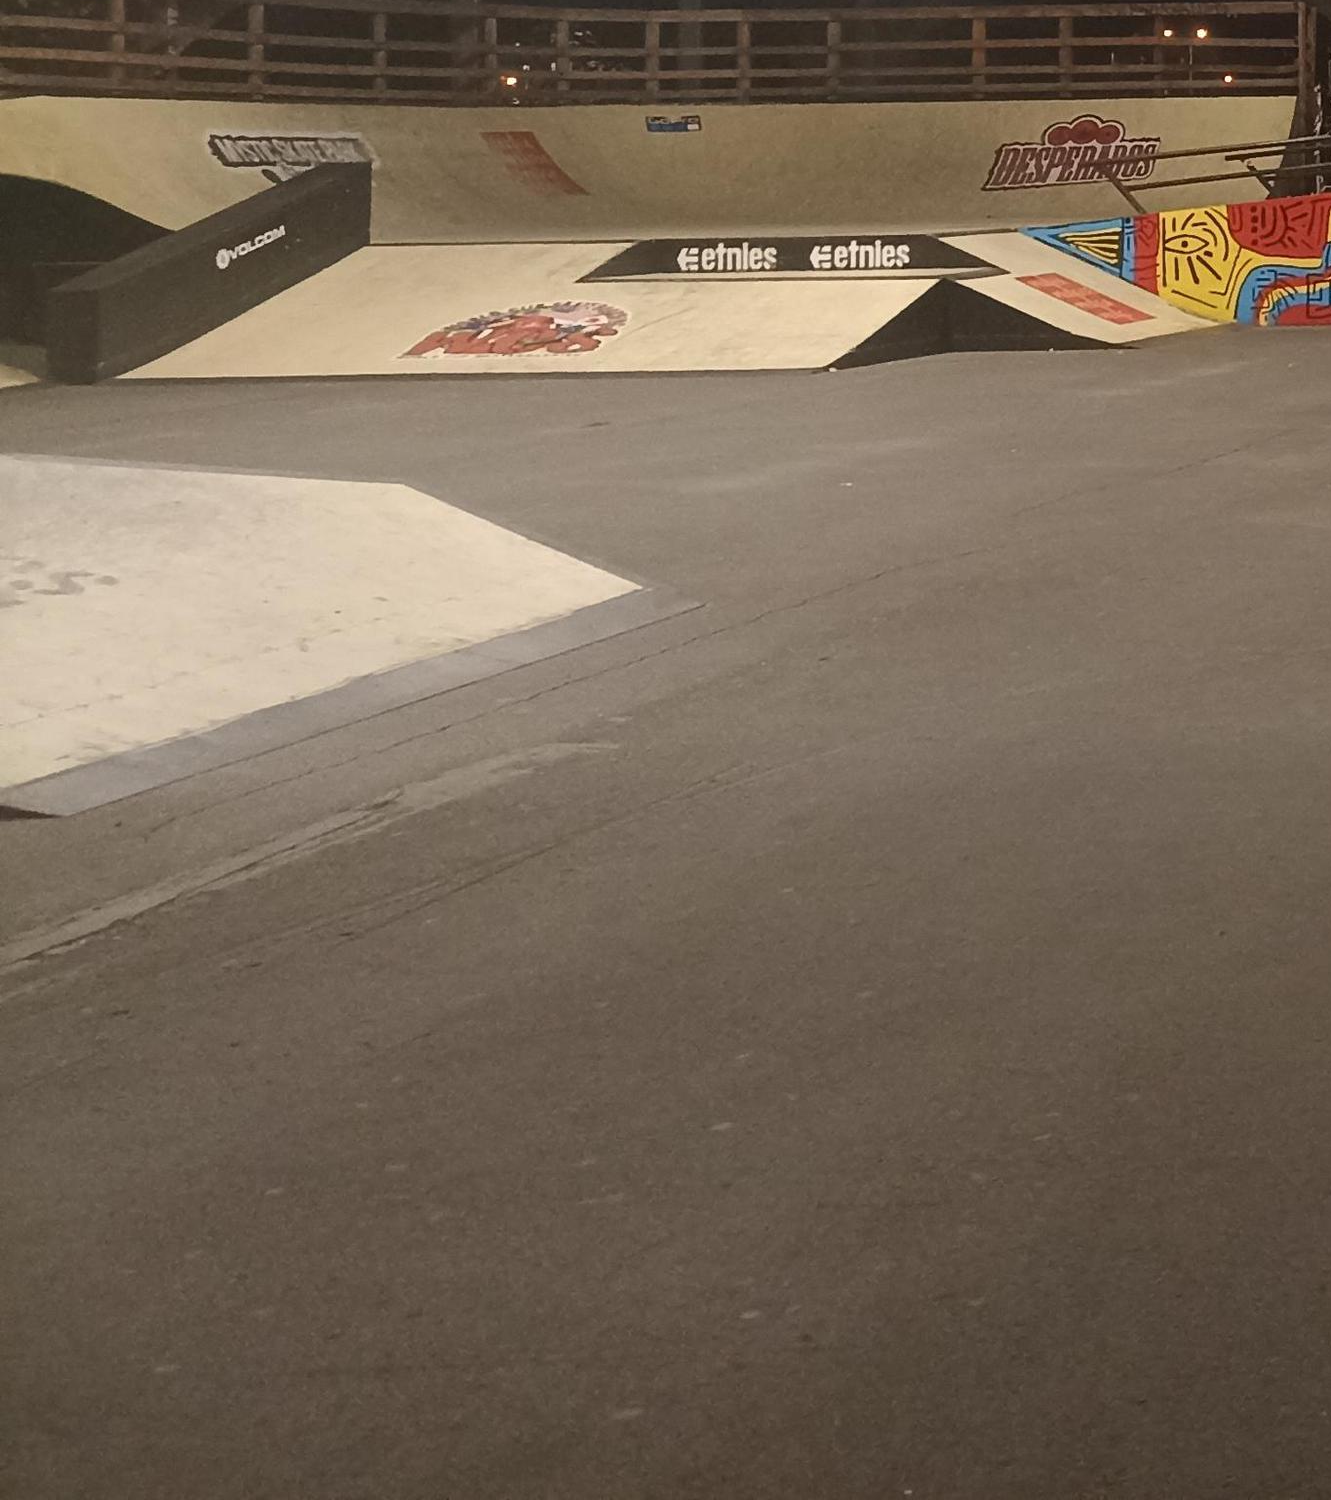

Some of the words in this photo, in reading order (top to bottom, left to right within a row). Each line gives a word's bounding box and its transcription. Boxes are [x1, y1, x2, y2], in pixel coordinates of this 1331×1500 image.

[991, 143, 1159, 187] DESPERADOS
[227, 225, 286, 260] VOLCOM
[701, 242, 778, 271] etnies
[834, 239, 911, 269] etnies
